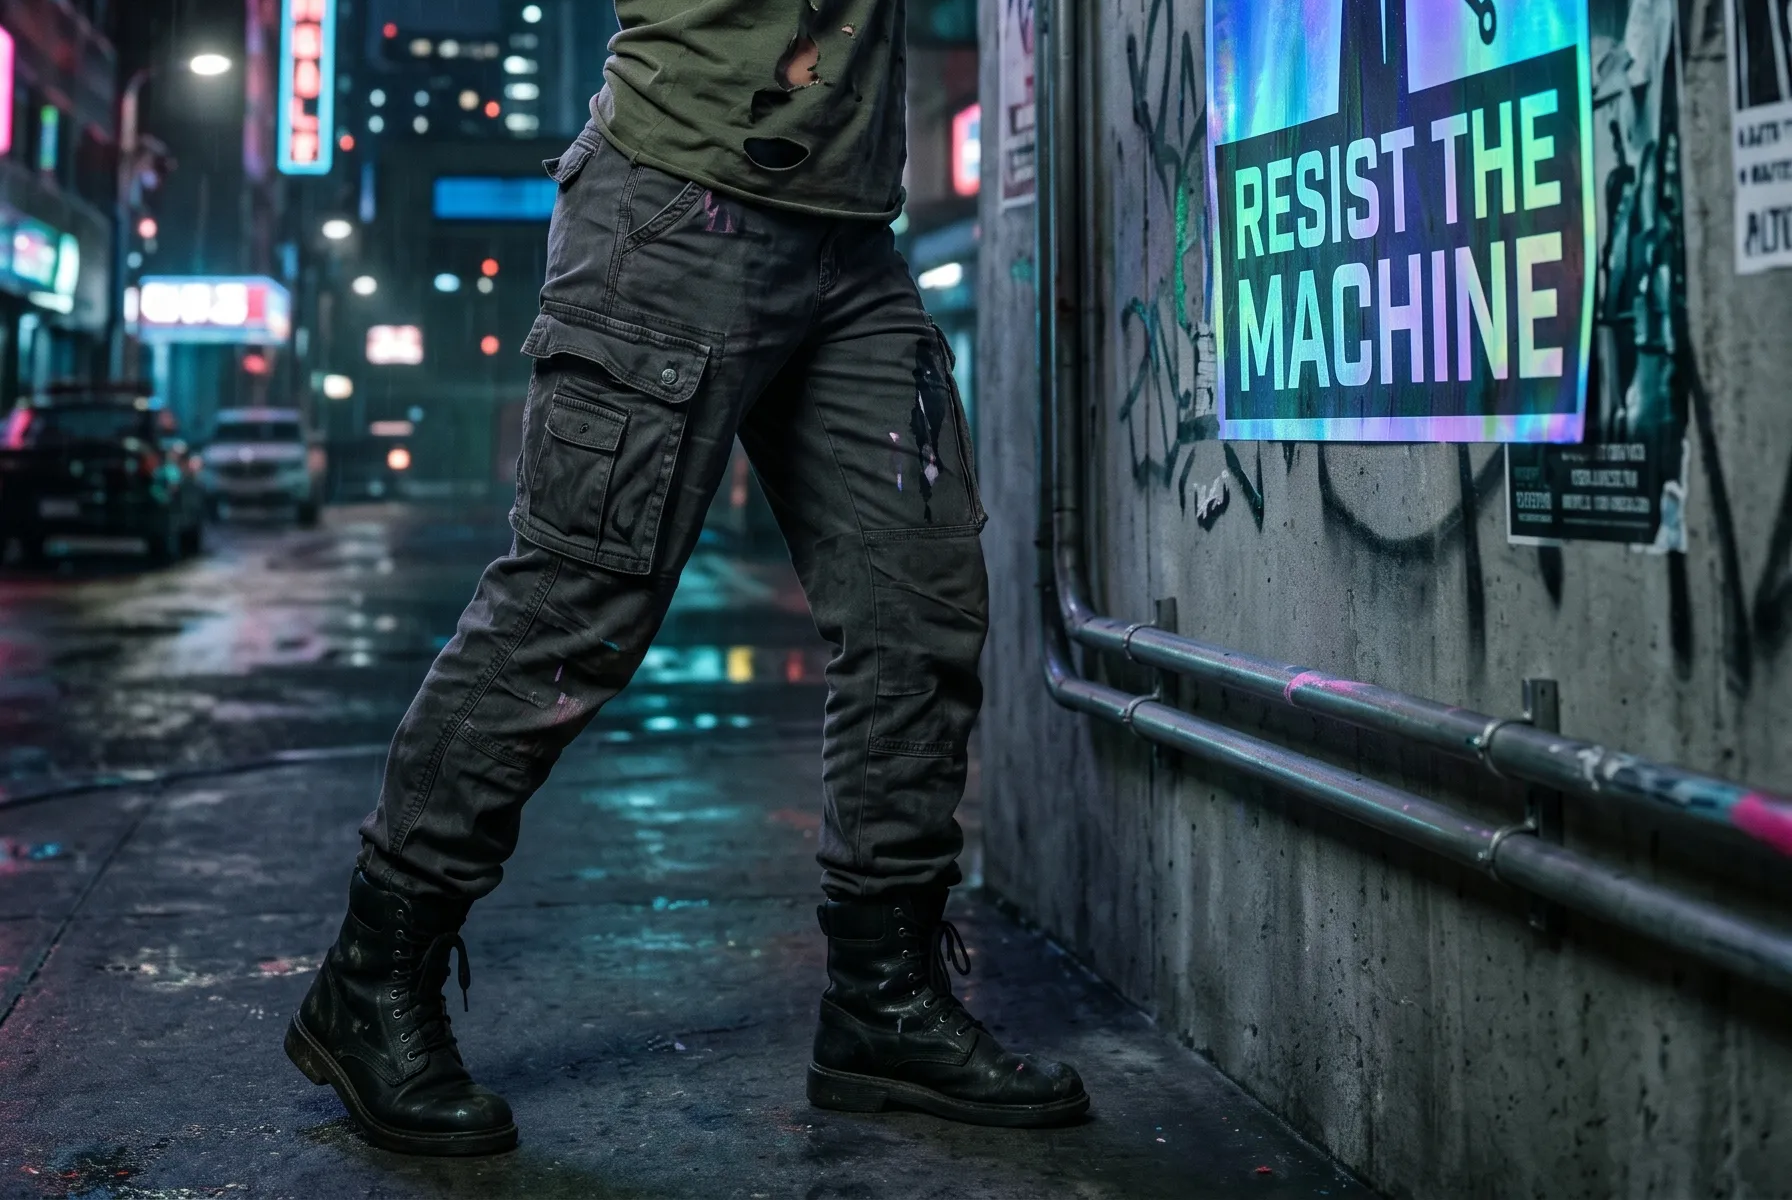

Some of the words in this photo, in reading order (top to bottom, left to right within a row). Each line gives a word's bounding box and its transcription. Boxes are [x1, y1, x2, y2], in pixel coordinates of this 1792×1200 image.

[1234, 126, 1415, 260] RESIST
[1430, 88, 1562, 225] THE
[1237, 231, 1564, 392] MACHINE
